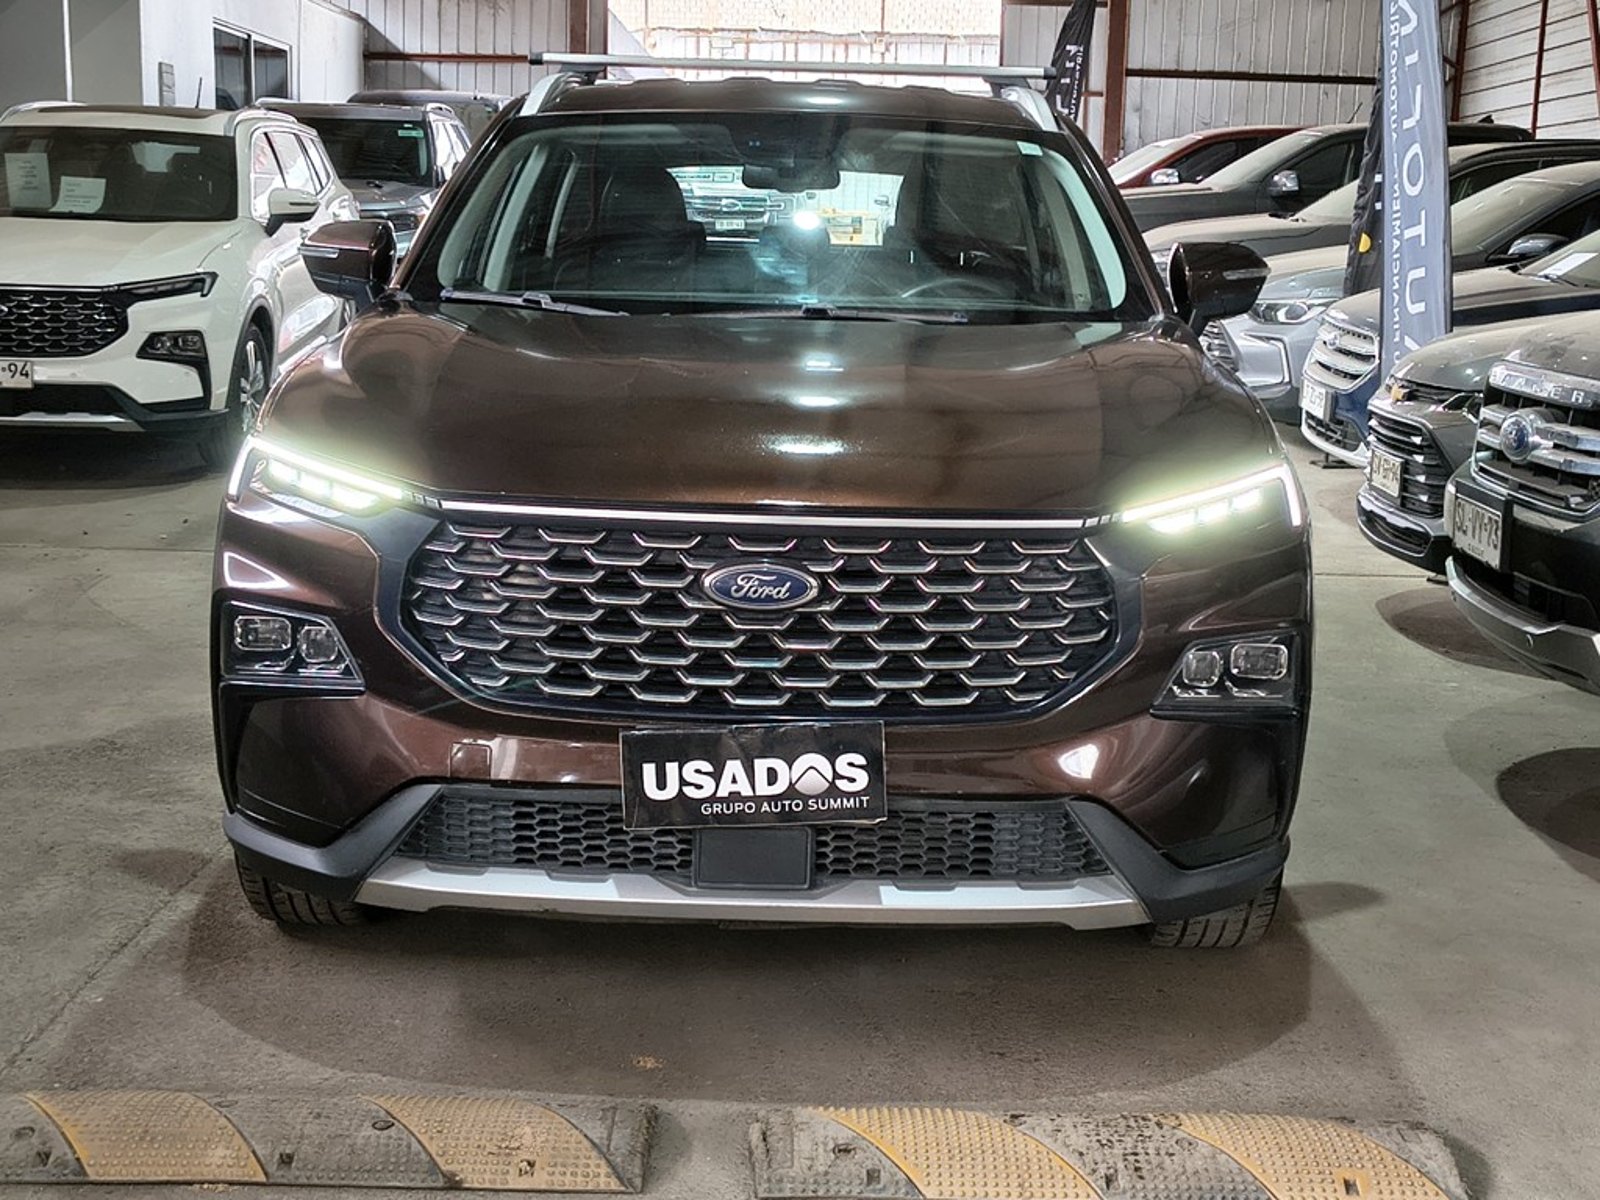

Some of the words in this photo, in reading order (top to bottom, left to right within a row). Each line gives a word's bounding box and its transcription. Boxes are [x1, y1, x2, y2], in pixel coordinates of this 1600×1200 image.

[730, 573, 791, 599] Ford
[642, 752, 870, 801] USADOS
[701, 802, 755, 815] GRUPO
[760, 799, 804, 814] AUTO
[807, 796, 870, 811] SUMMIT
